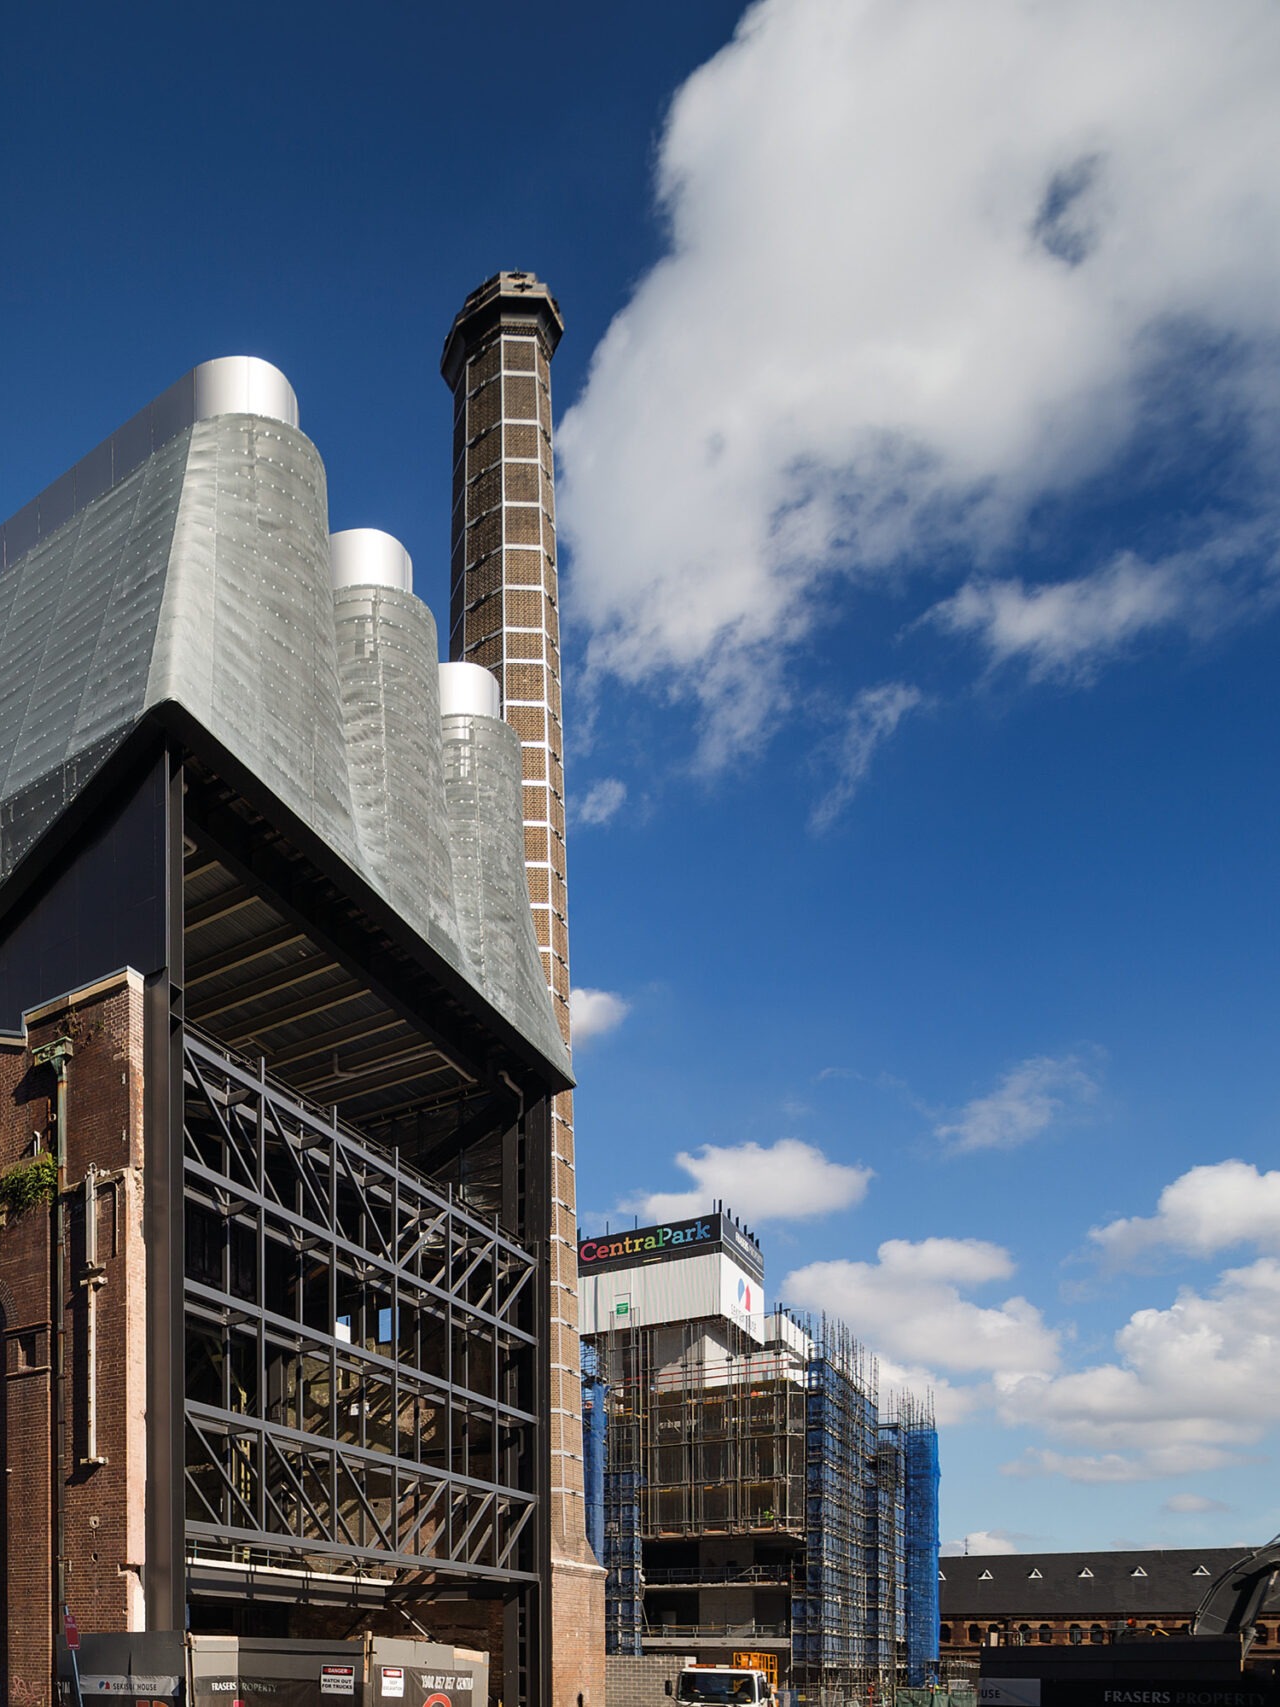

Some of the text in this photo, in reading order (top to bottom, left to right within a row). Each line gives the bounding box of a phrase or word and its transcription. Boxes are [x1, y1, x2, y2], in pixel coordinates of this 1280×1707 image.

[580, 1221, 710, 1261] CentralPark
[137, 1683, 157, 1691] HOUSE
[211, 1681, 237, 1691] FRASERS
[1104, 1690, 1268, 1706] FRASERS PROPERTY
